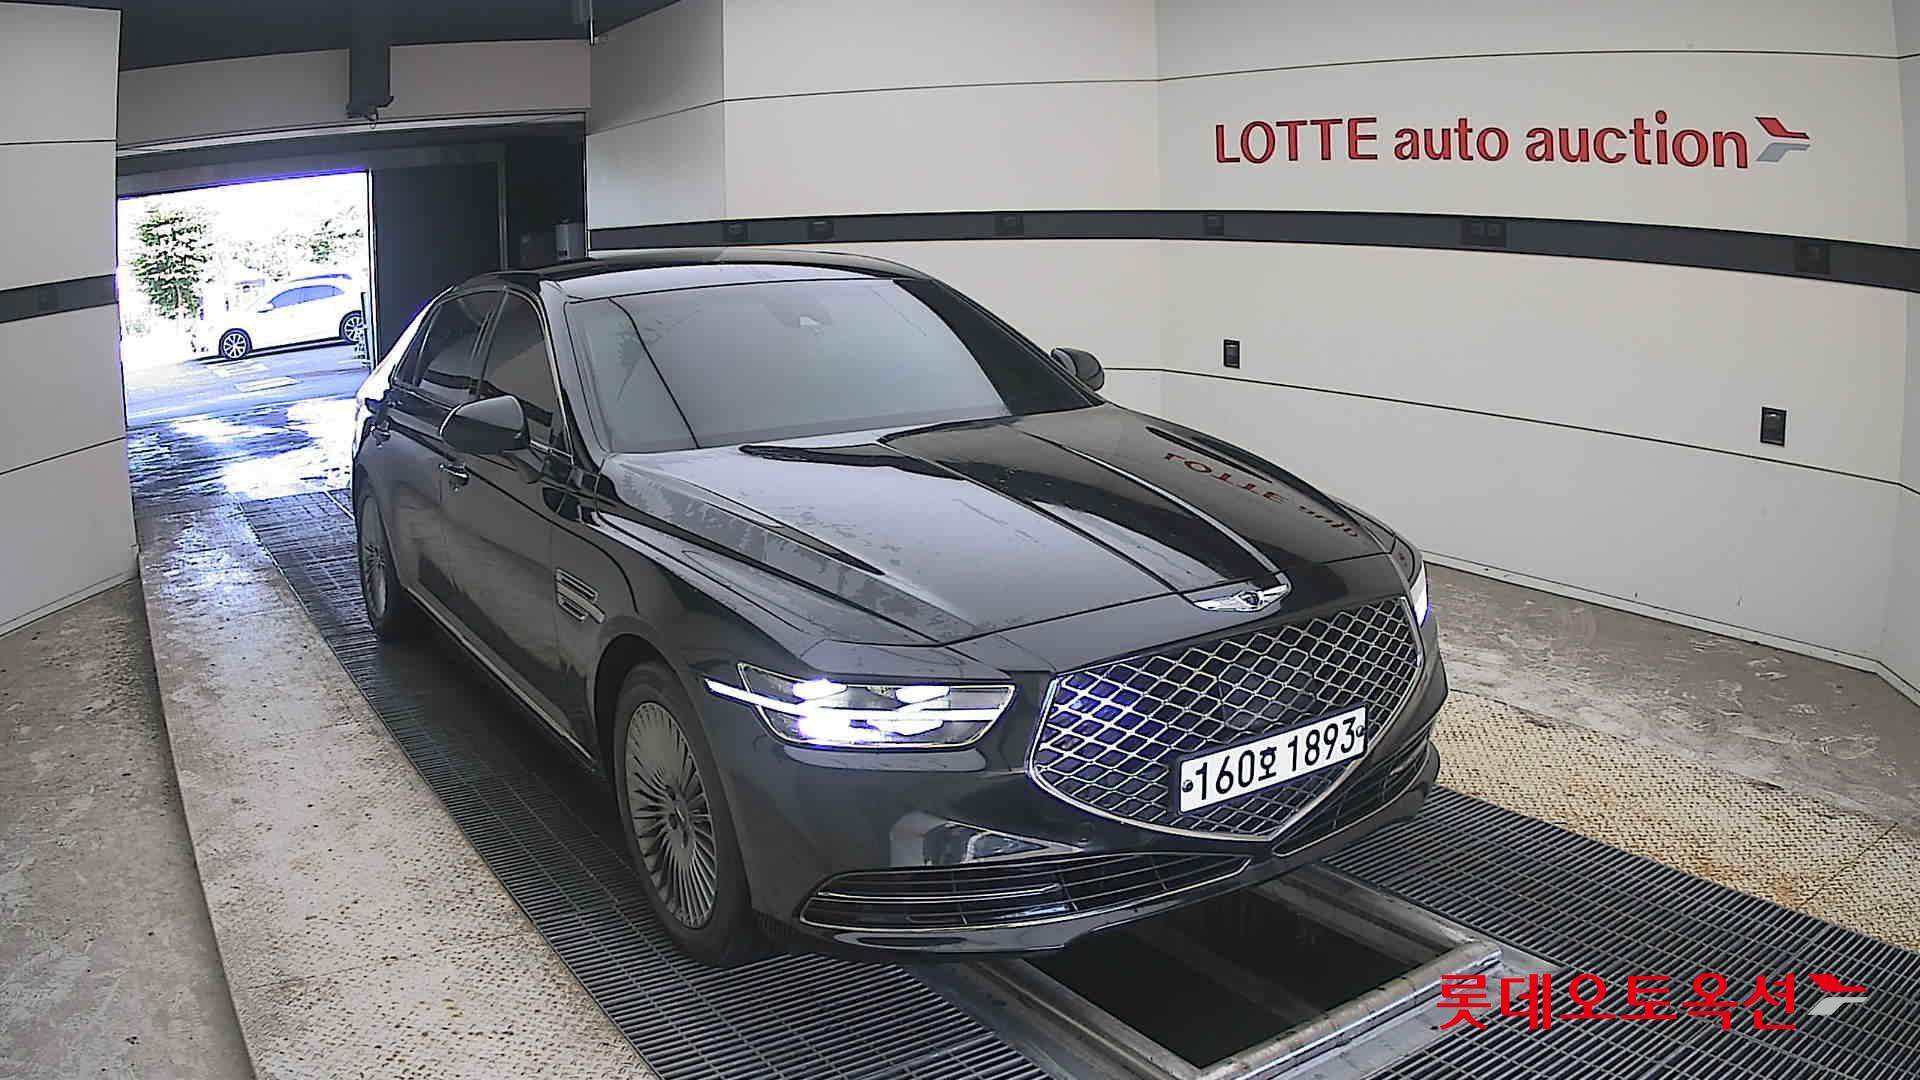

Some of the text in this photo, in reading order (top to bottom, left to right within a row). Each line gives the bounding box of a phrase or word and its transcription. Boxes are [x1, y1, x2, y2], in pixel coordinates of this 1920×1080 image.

[1215, 110, 1749, 169] LOTTE auto auction
[1195, 716, 1357, 801] 160호 1893
